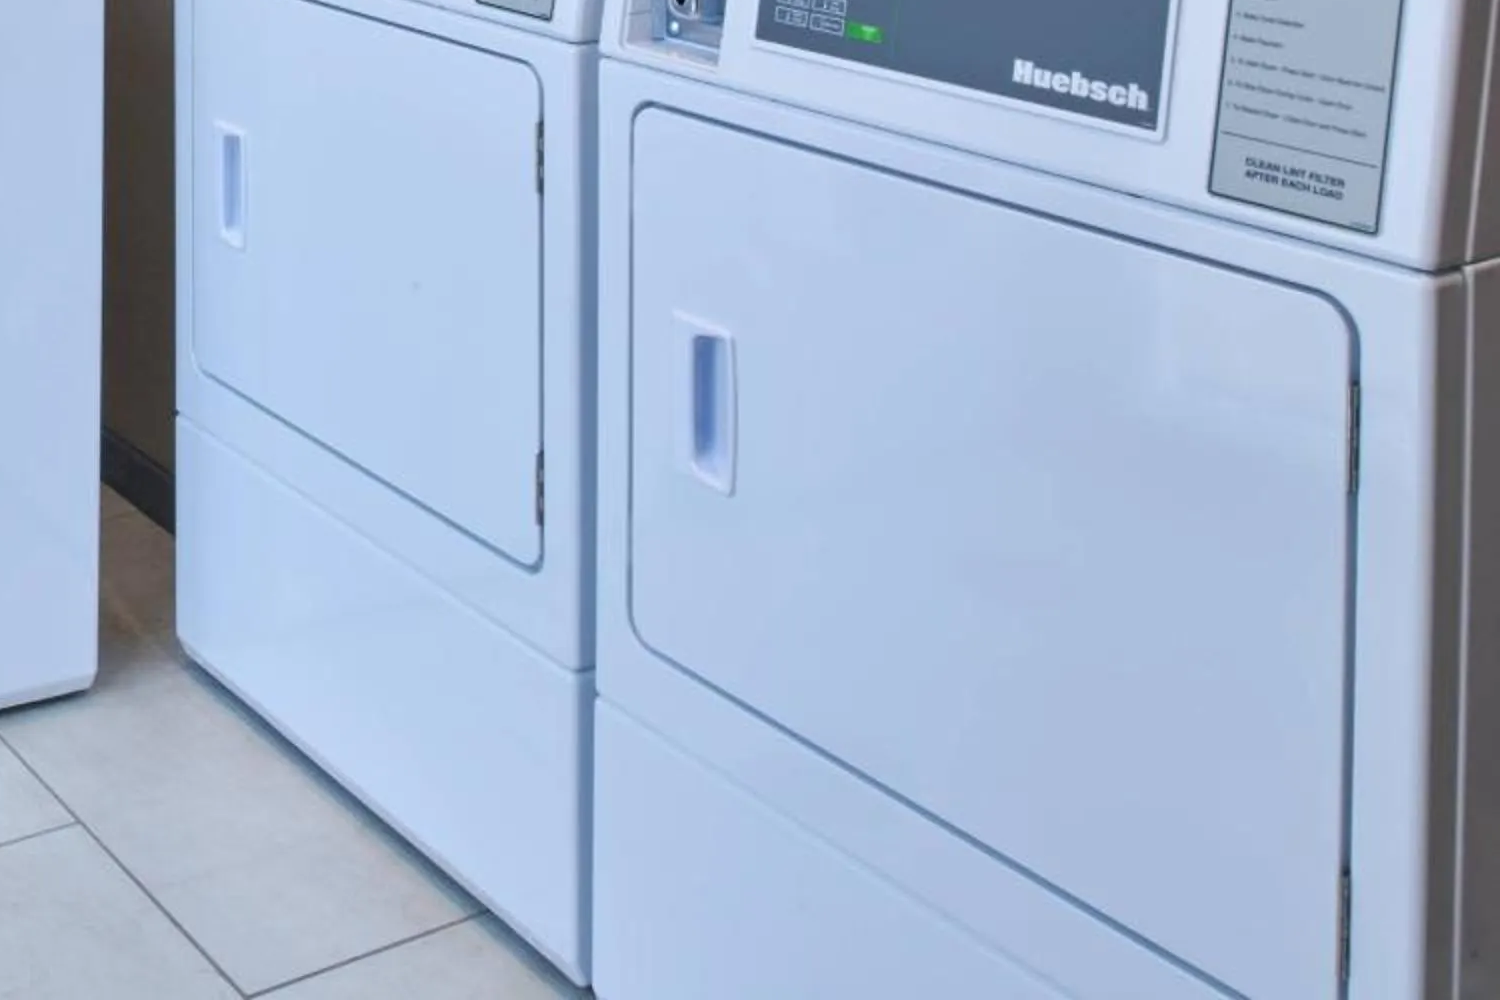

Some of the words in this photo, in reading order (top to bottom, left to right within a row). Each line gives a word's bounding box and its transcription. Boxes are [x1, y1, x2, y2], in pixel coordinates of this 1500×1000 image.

[1011, 57, 1150, 112] Huebsch
[1244, 156, 1281, 173] CLEAN
[1307, 171, 1346, 189] FILTER
